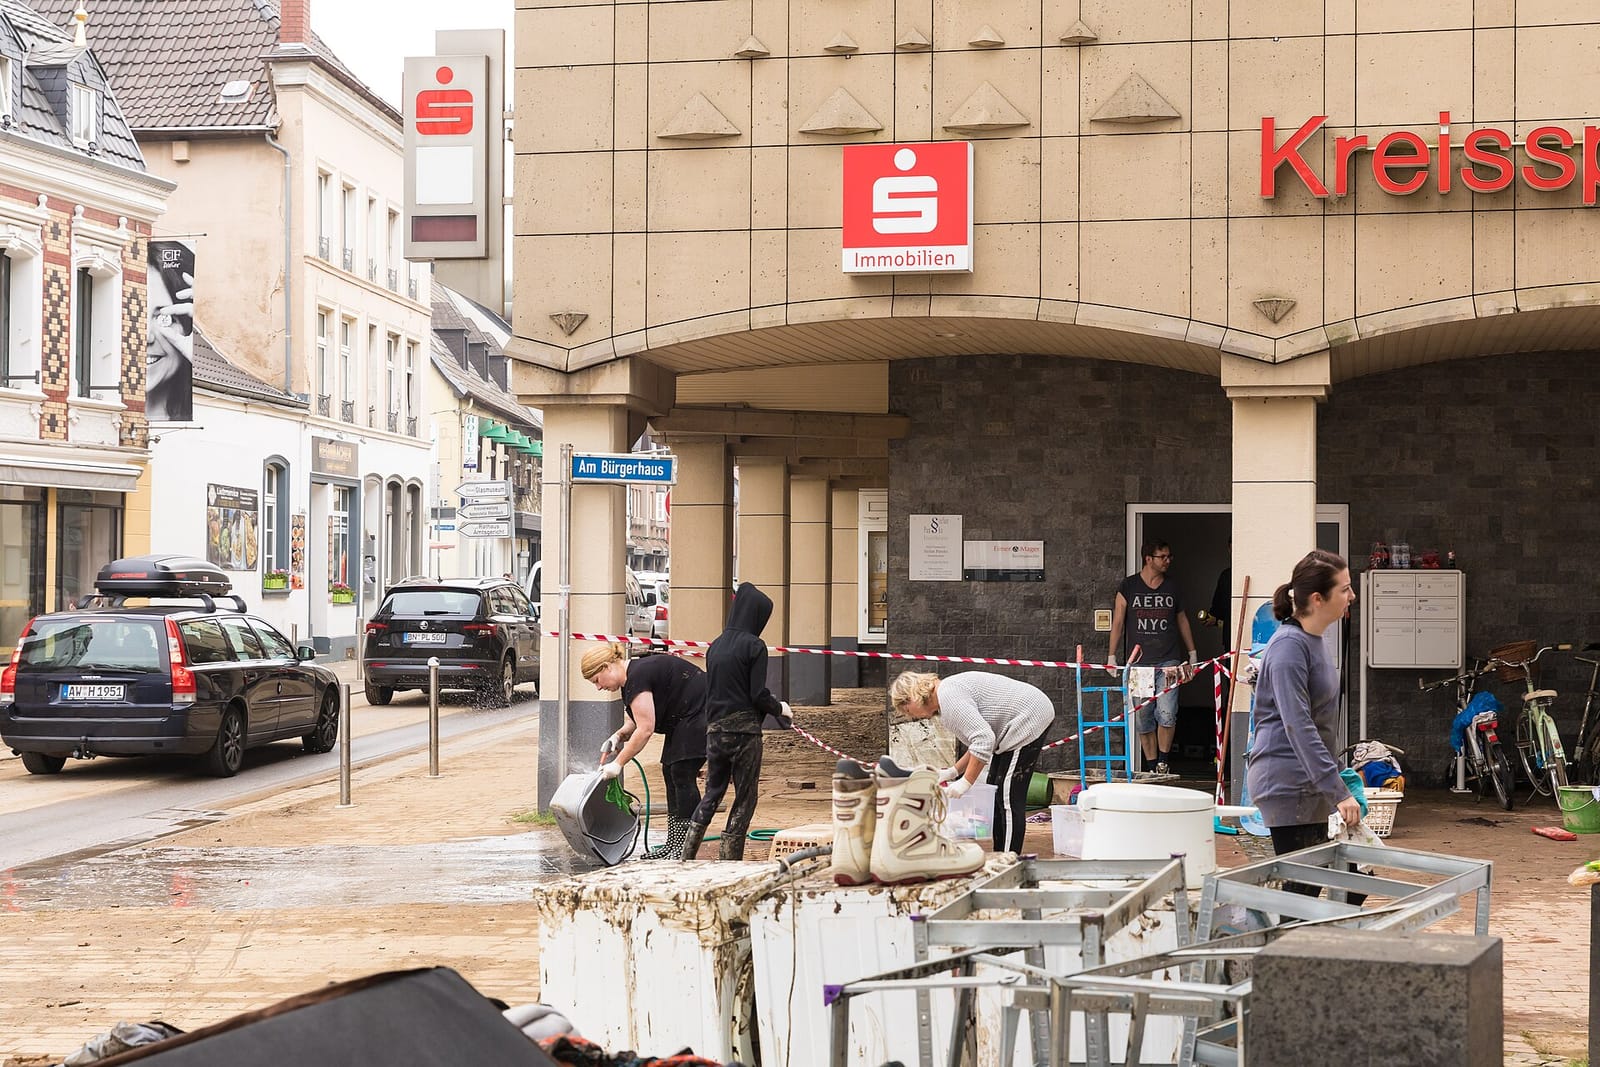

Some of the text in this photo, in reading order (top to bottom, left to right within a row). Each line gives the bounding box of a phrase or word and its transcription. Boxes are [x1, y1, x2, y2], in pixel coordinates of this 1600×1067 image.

[855, 250, 955, 268] Immobilien
[466, 416, 475, 453] HOTEL
[578, 459, 664, 478] Am Bürgerhaus
[475, 486, 505, 494] Glasmuseum
[472, 529, 505, 537] Amtsgericht
[1132, 595, 1174, 608] AERO
[1137, 618, 1168, 631] NYC
